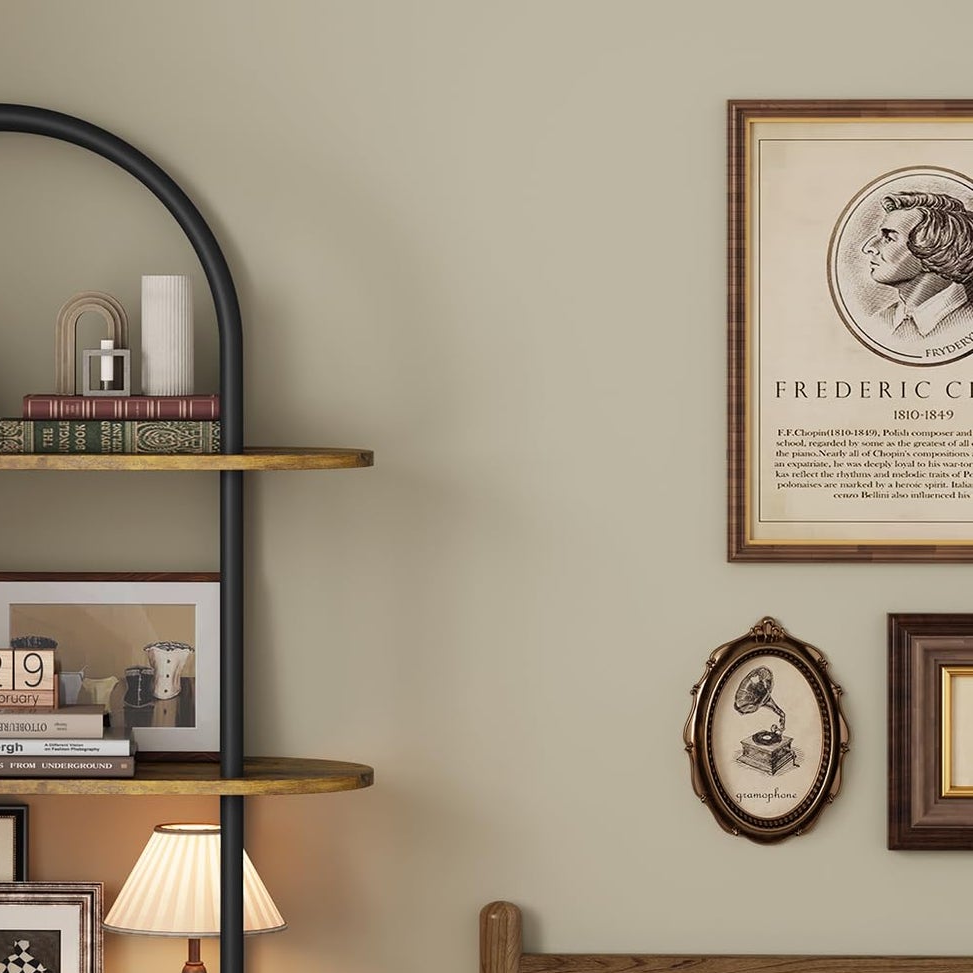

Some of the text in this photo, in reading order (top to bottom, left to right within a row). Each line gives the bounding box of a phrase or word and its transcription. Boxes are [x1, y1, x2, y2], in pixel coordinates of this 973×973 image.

[776, 381, 973, 399] FREDERIC C
[893, 409, 955, 421] 1810-1849
[43, 427, 53, 448] THE
[74, 424, 86, 450] BOOK
[883, 429, 909, 437] Polish
[911, 430, 954, 438] composer
[956, 429, 973, 437] and
[808, 440, 847, 448] regarded
[848, 440, 860, 448] by
[872, 450, 911, 458] Chopin's
[912, 450, 970, 458] compositions
[863, 460, 892, 469] deeply
[894, 460, 915, 469] loyal
[836, 471, 872, 479] rhythms
[777, 481, 822, 489] polonaises
[875, 481, 885, 490] by
[735, 787, 798, 803] gramophone
